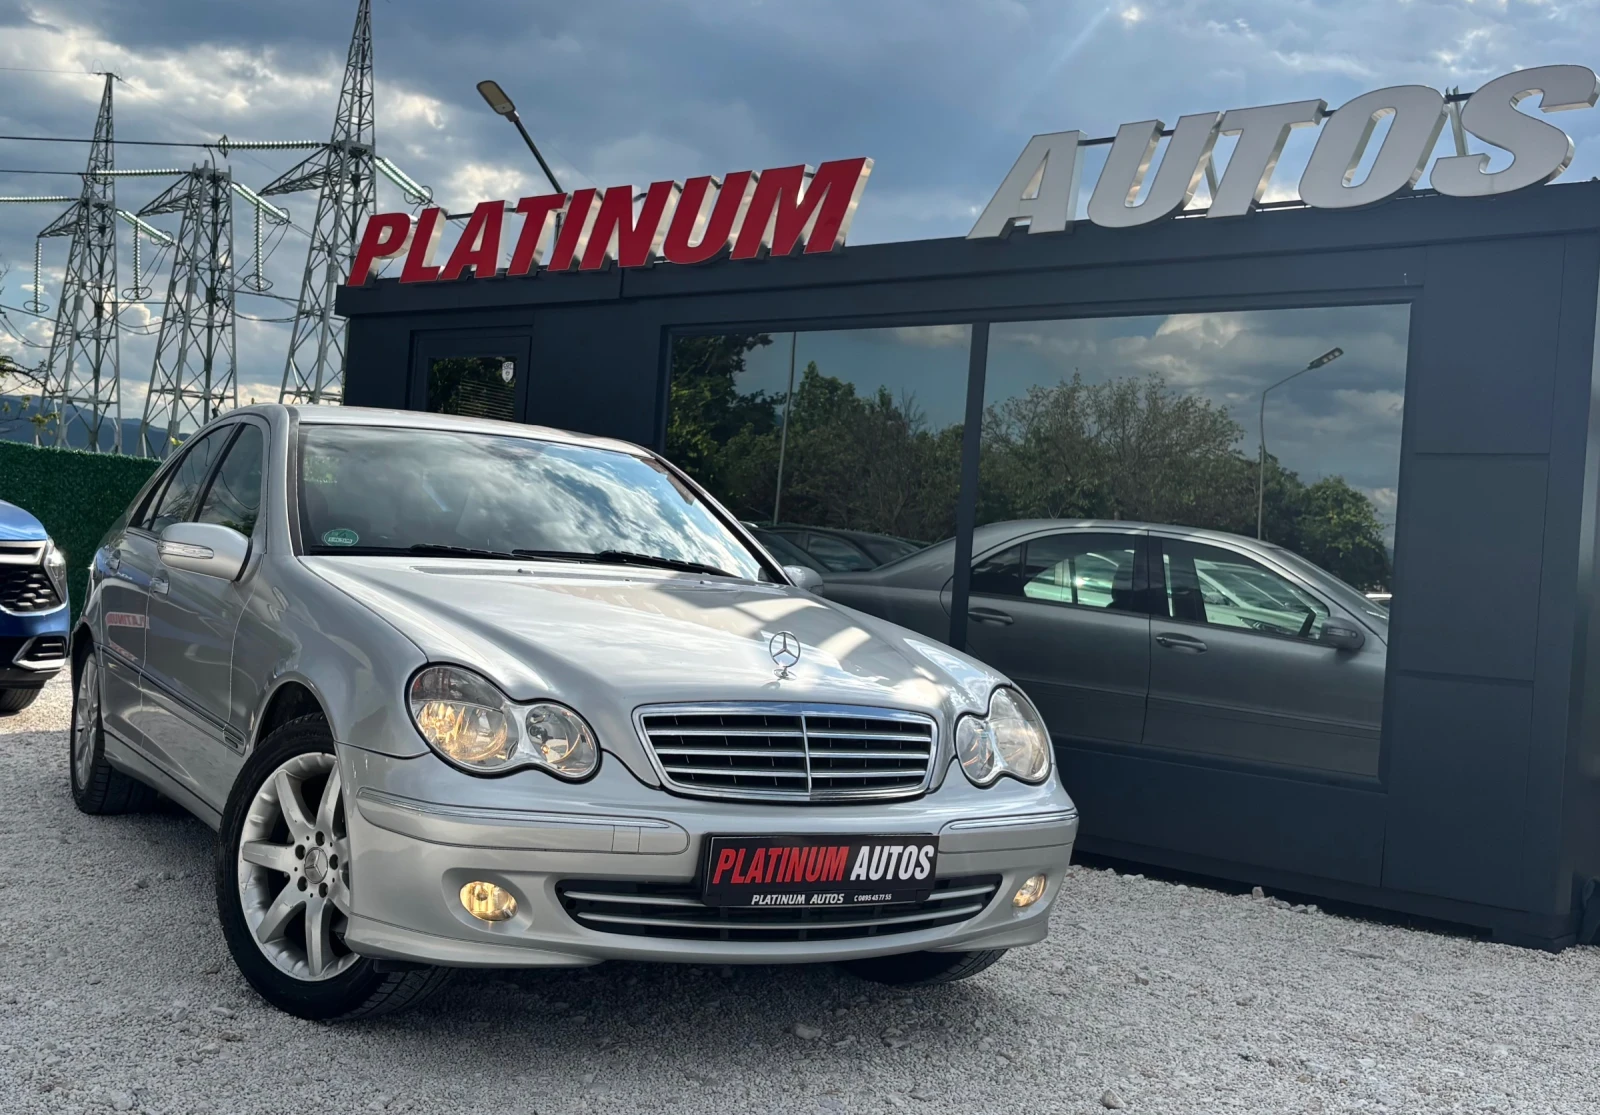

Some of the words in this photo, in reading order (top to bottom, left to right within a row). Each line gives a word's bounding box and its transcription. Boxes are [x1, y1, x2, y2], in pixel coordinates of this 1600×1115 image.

[346, 157, 873, 286] PLATINUM
[966, 65, 1600, 239] AUTOS
[712, 846, 850, 884] PLATINUM
[850, 844, 935, 881] AUTOS
[751, 893, 806, 905] PLATINUM
[810, 893, 844, 904] AUTOS
